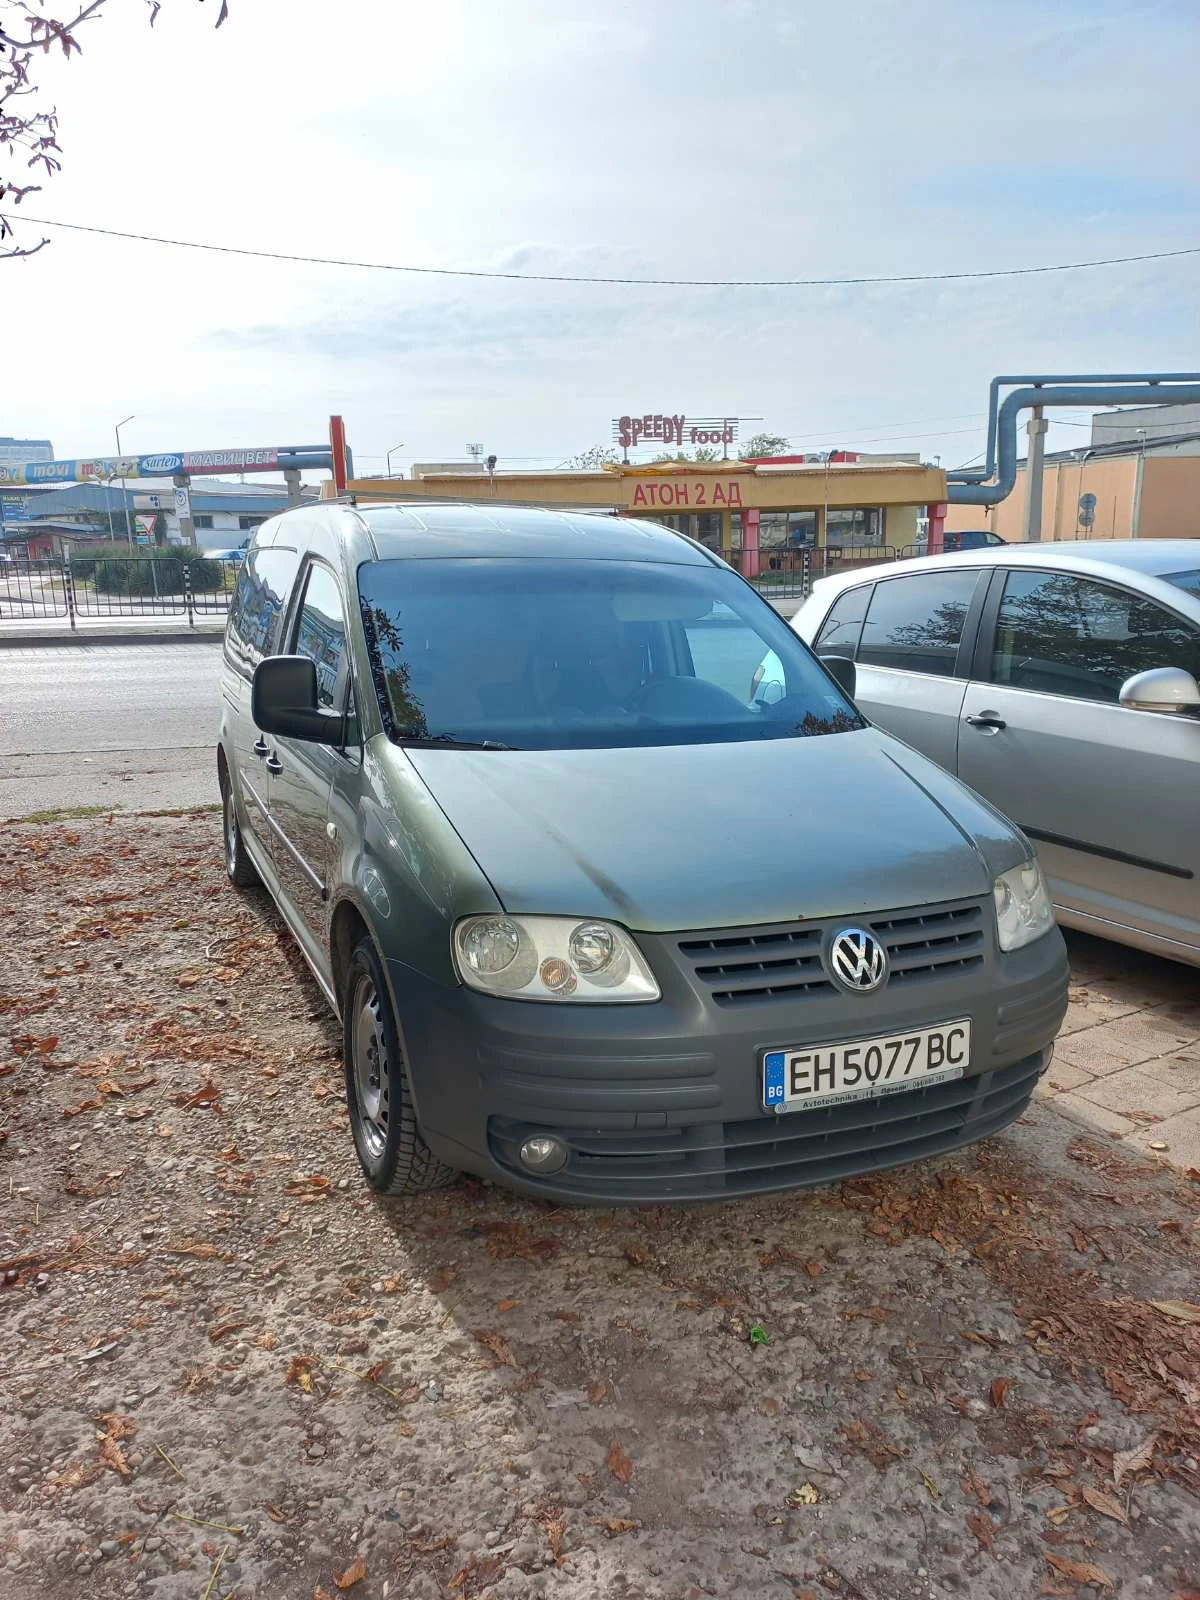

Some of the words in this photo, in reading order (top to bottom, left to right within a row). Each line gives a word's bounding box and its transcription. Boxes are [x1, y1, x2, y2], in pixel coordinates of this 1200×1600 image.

[618, 415, 684, 446] SPEEDY
[690, 425, 734, 444] food
[190, 451, 272, 468] МАРИЦВЕТ
[633, 482, 689, 505] АТОН
[694, 483, 706, 505] 2
[711, 482, 742, 507] АД
[768, 1085, 783, 1099] BG
